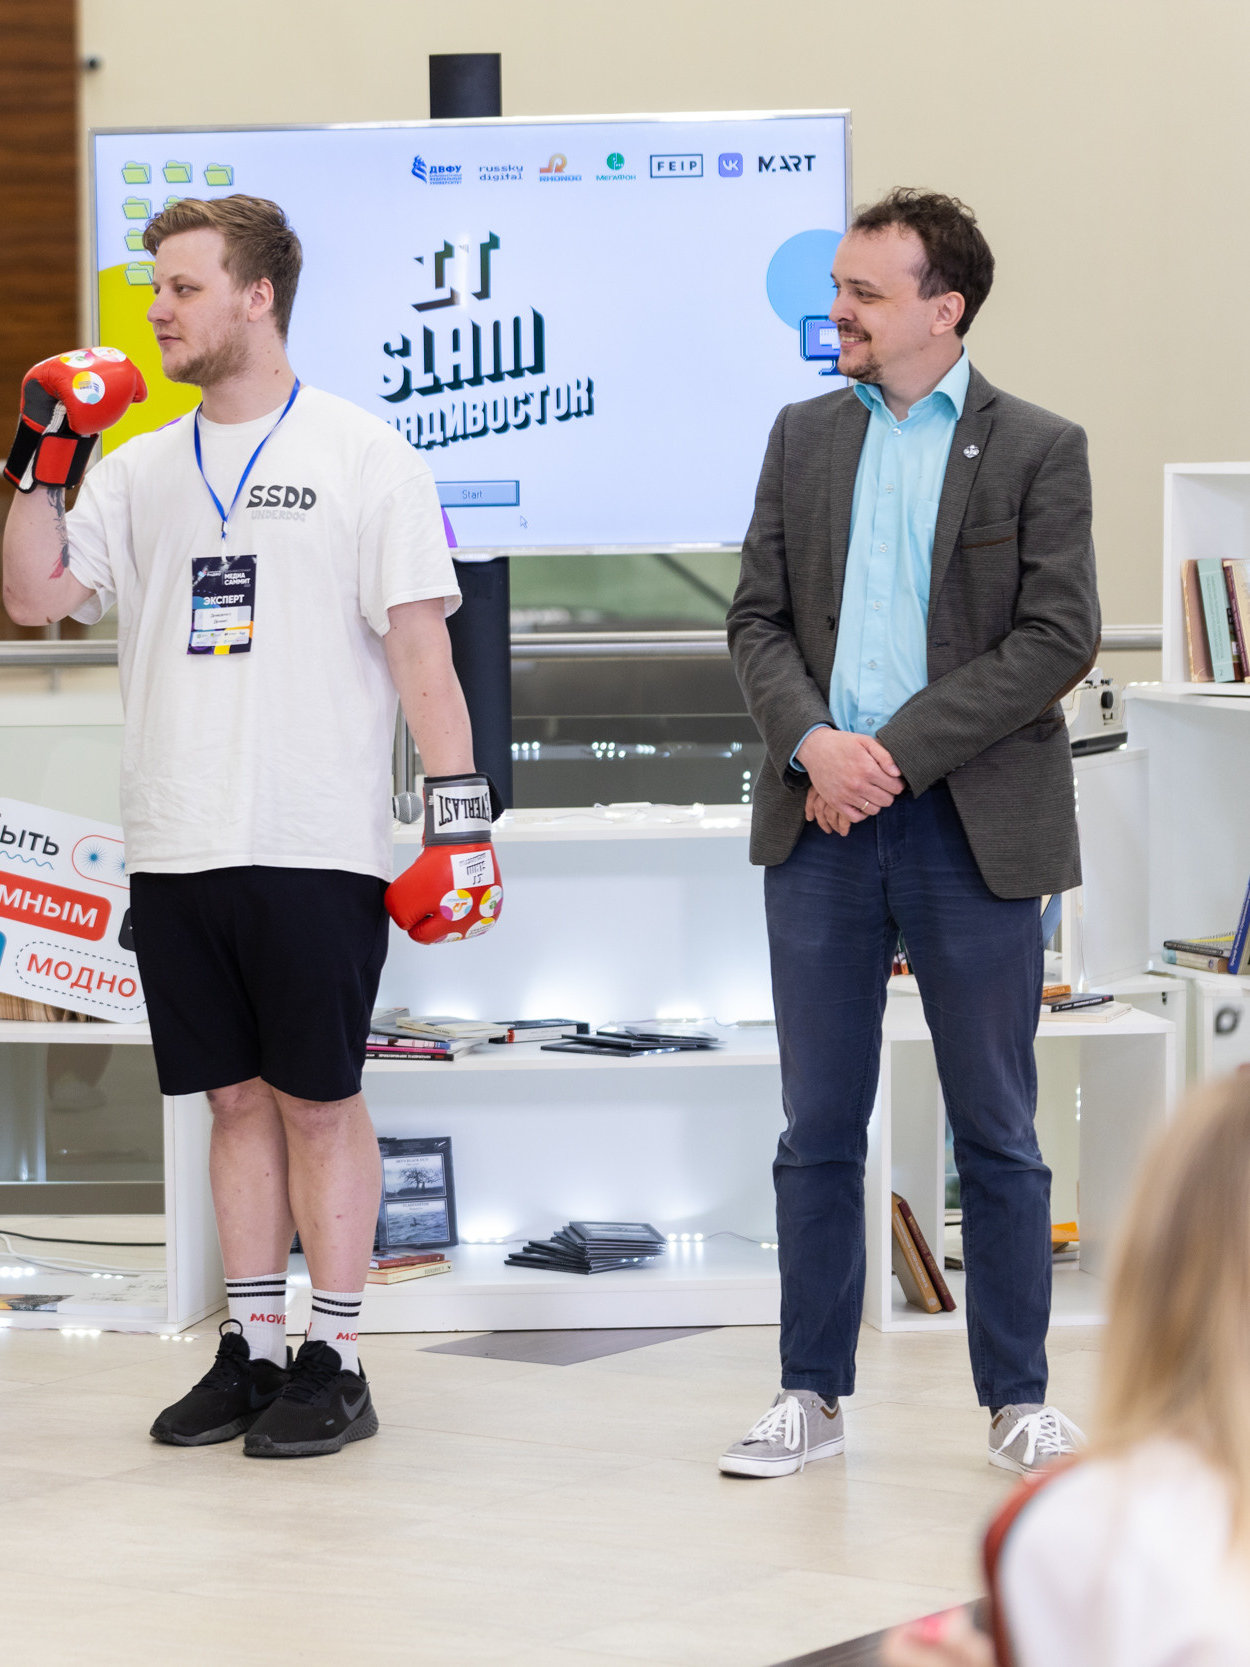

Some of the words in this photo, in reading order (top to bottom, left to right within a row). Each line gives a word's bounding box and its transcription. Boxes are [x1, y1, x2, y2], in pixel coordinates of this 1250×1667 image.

[429, 165, 462, 174] ДВФУ
[479, 165, 523, 173] russky
[657, 160, 698, 172] FEIP
[722, 159, 740, 171] VK
[479, 173, 523, 182] digital
[403, 231, 500, 312] IT
[377, 305, 545, 403] SLAM
[387, 376, 594, 450] АДИВОСТОК
[246, 485, 317, 511] SSDD
[462, 489, 483, 500] Start
[251, 510, 306, 523] UNDERDOG
[224, 578, 251, 586] САММИТ
[203, 594, 245, 606] ЭКСПЕРТ
[435, 792, 492, 827] EVERLAST
[26, 953, 138, 998] модно
